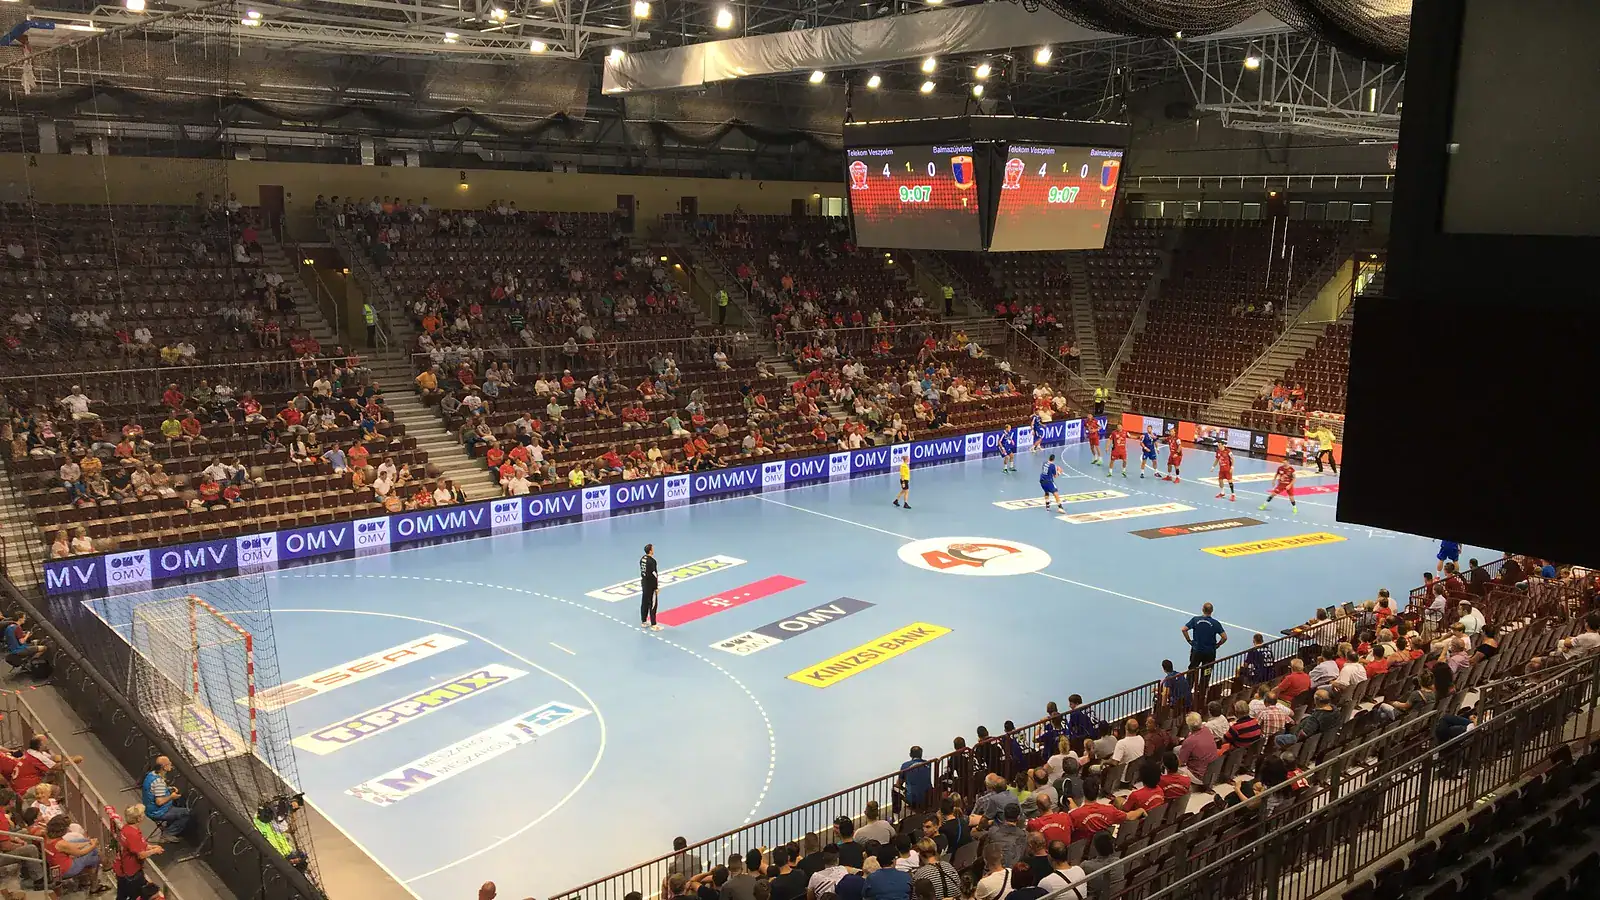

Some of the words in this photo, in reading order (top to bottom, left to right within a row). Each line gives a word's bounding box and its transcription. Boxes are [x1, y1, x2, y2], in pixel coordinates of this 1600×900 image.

[847, 149, 868, 157] Telekom
[1008, 145, 1030, 154] Telekom
[882, 163, 891, 178] 4
[905, 161, 914, 172] 1.
[927, 162, 936, 177] 0
[1038, 162, 1047, 177] 4
[1062, 162, 1069, 173] 1.
[1080, 163, 1089, 179] 0
[899, 185, 932, 202] 9:07
[1047, 186, 1080, 203] 9:07
[854, 450, 887, 469] OMV
[789, 459, 825, 477] OMV
[832, 464, 849, 474] OMV
[764, 473, 783, 483] OMV
[616, 483, 659, 503] OMV
[667, 487, 689, 498] OMV
[528, 495, 576, 517] OMV
[585, 499, 608, 511] OMV
[494, 512, 518, 525] OMV
[286, 527, 346, 553] OMV
[358, 532, 387, 545] OMV
[1283, 533, 1335, 547] BANK
[160, 544, 228, 572] OMV
[241, 549, 273, 563] OMV
[111, 567, 146, 582] OMV
[778, 603, 847, 633] OMV
[806, 648, 882, 682] KINIZSI
[878, 625, 936, 653] BANK
[313, 639, 439, 685] SEAT
